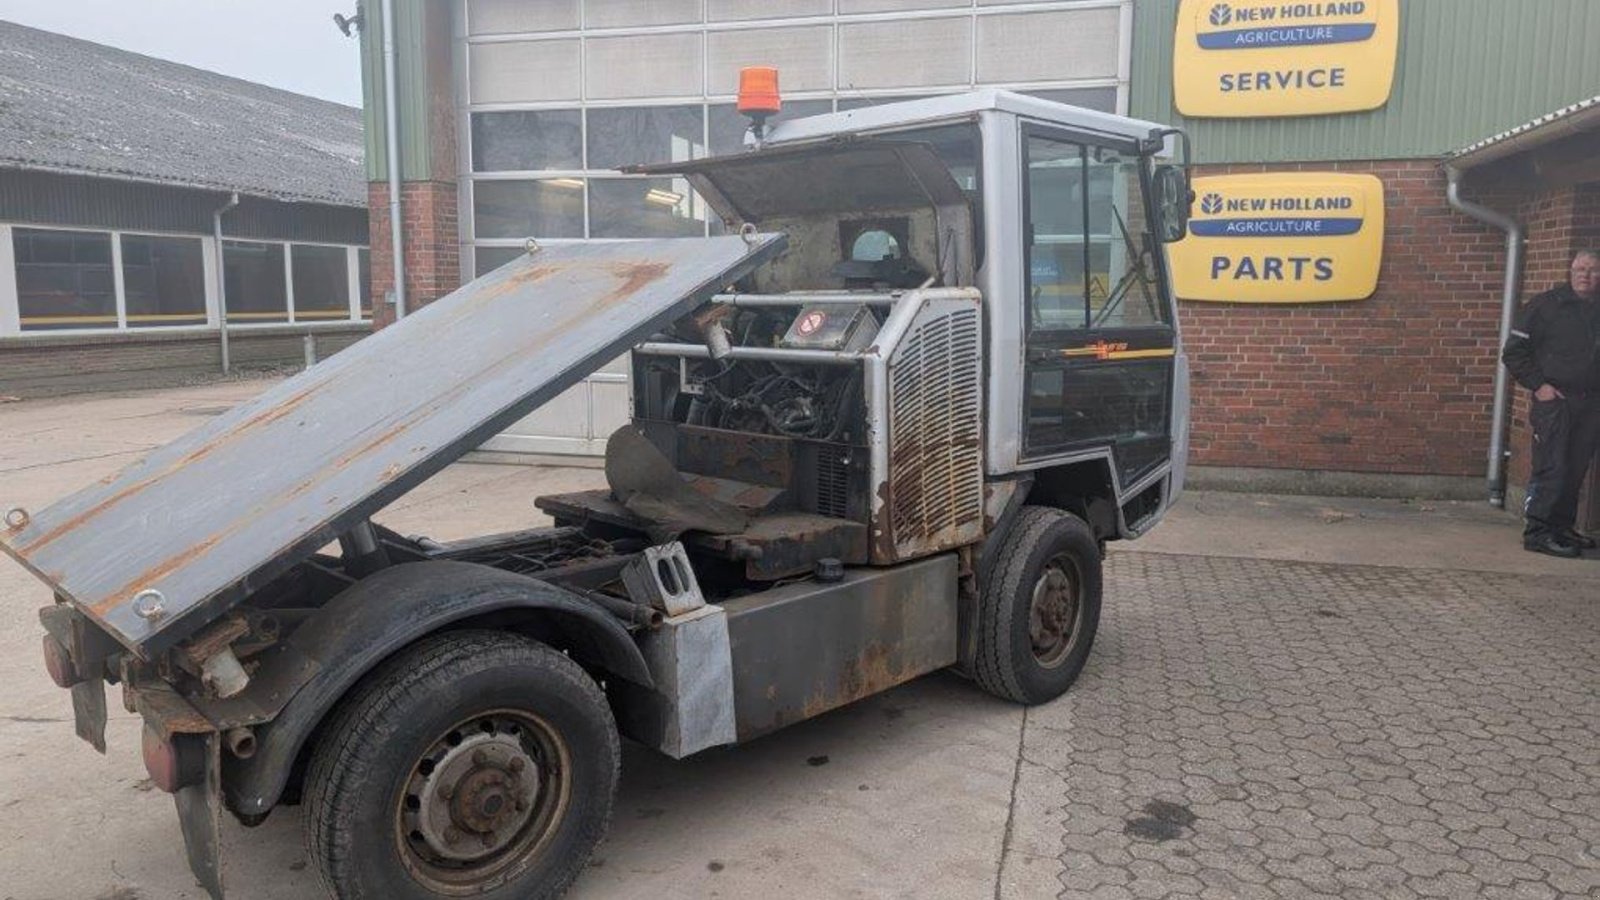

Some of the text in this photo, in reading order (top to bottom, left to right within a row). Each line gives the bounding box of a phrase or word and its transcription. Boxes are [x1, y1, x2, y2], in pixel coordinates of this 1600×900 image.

[1235, 1, 1365, 22] NEW HOLLAND
[1235, 27, 1333, 44] AGRICULTURE
[1219, 68, 1345, 92] SERVICE
[1227, 196, 1352, 212] NEW HOLLAND
[1226, 220, 1322, 233] AGRICULTURE
[1210, 256, 1334, 281] PARTS
